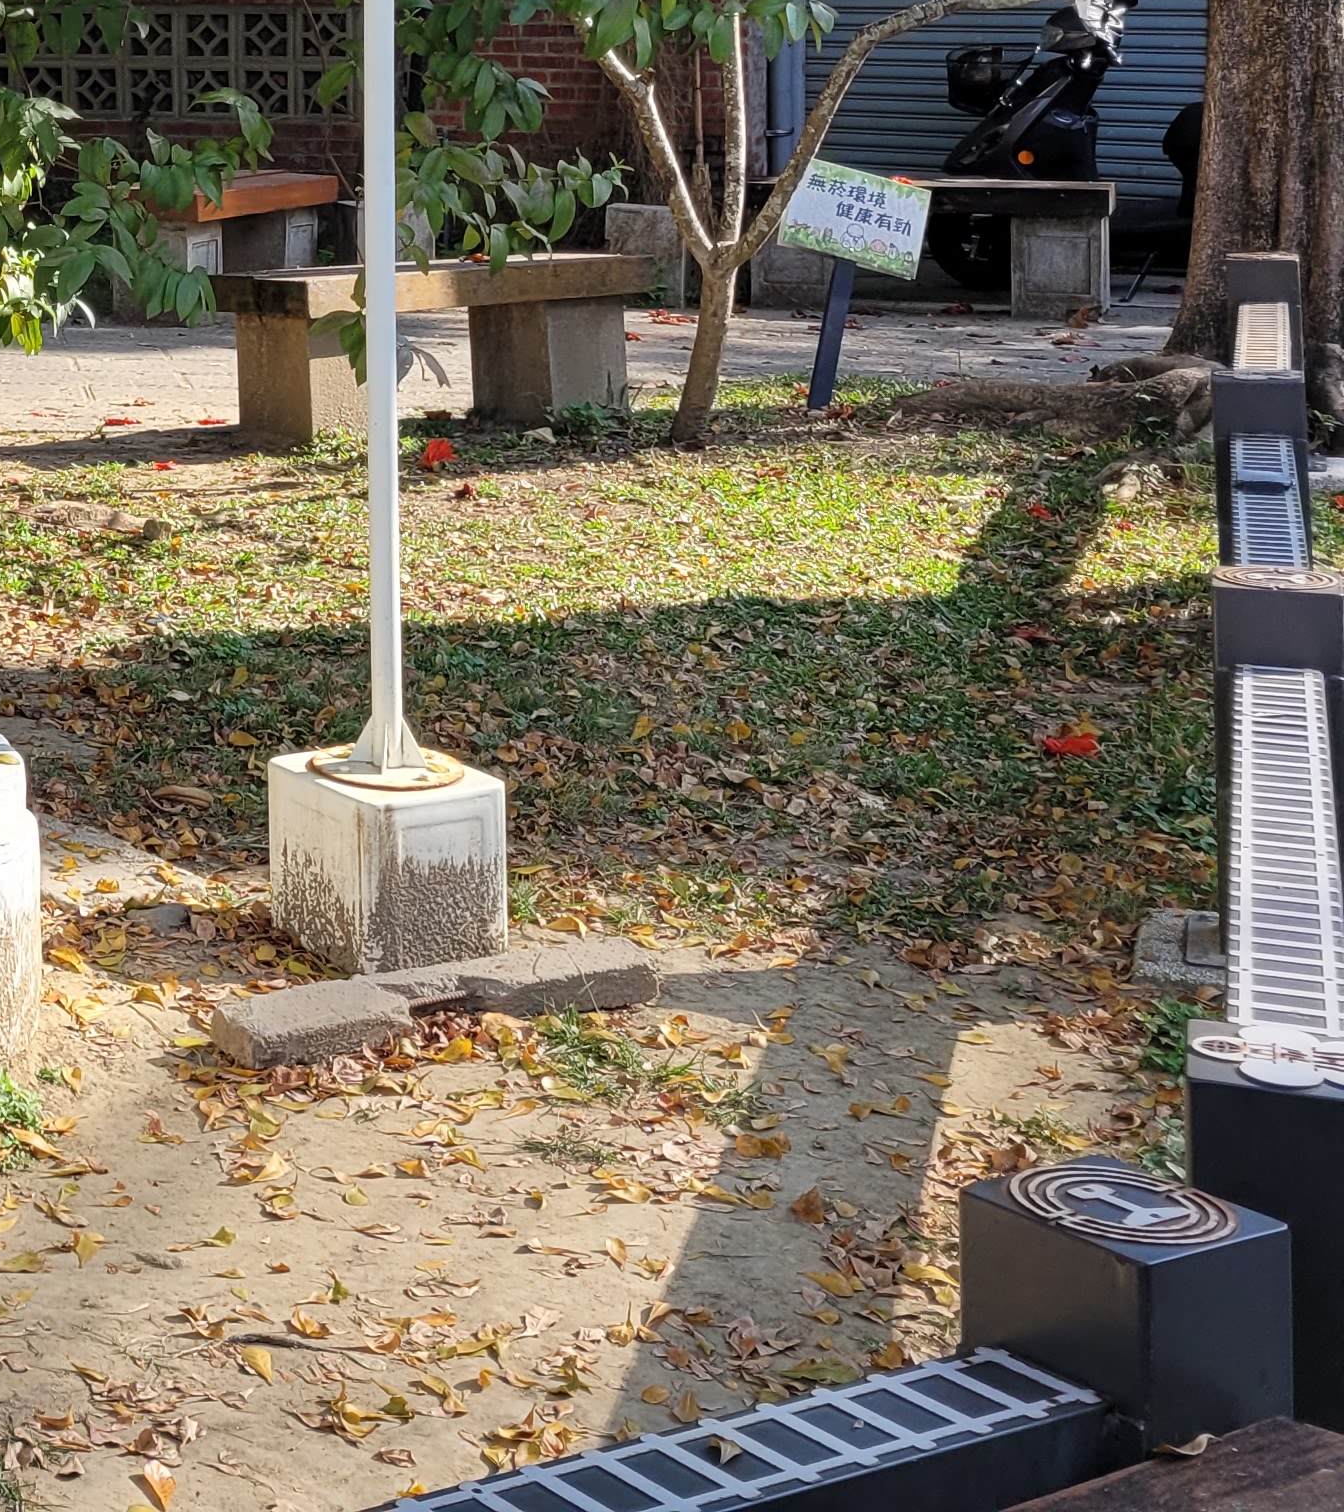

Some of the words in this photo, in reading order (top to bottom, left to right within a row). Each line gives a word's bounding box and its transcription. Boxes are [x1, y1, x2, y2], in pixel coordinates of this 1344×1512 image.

[806, 173, 887, 210] 無菸環境
[835, 200, 912, 237] 健康有勁
